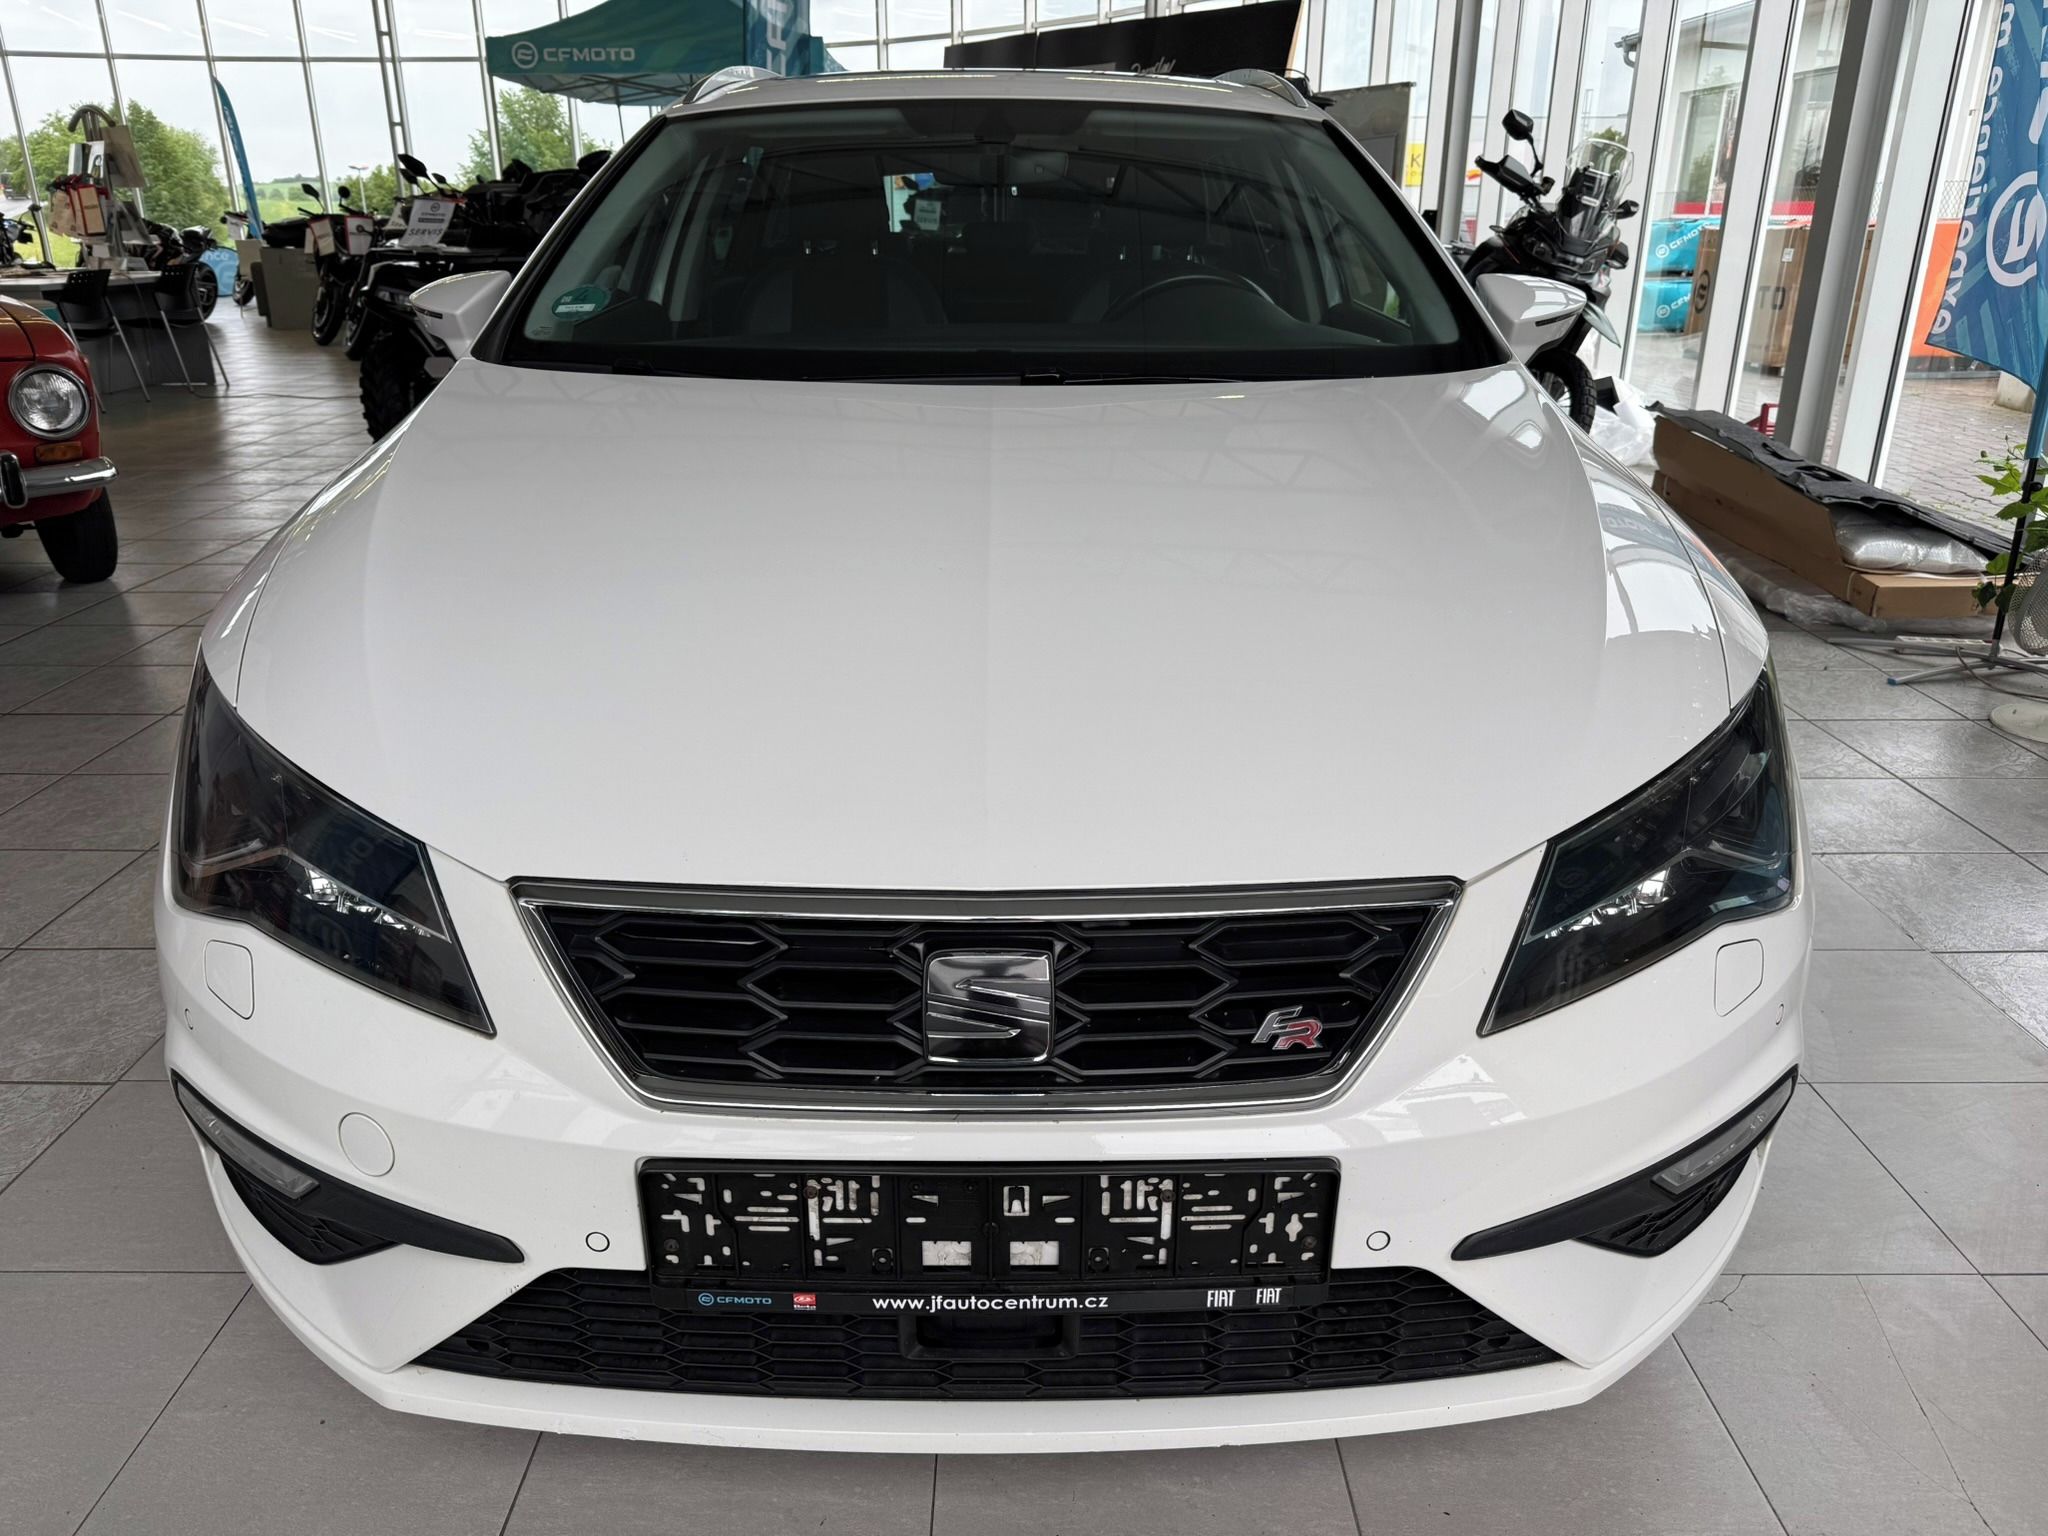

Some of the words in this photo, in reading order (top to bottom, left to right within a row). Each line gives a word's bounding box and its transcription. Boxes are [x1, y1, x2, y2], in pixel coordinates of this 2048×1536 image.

[543, 48, 636, 62] CFMOTO
[1251, 1005, 1323, 1050] FR
[717, 1296, 772, 1305] CFMOTO
[872, 1295, 1109, 1313] www.jfautocentrum.cz
[1206, 1289, 1236, 1308] FIAT
[1255, 1287, 1283, 1304] FIAT
